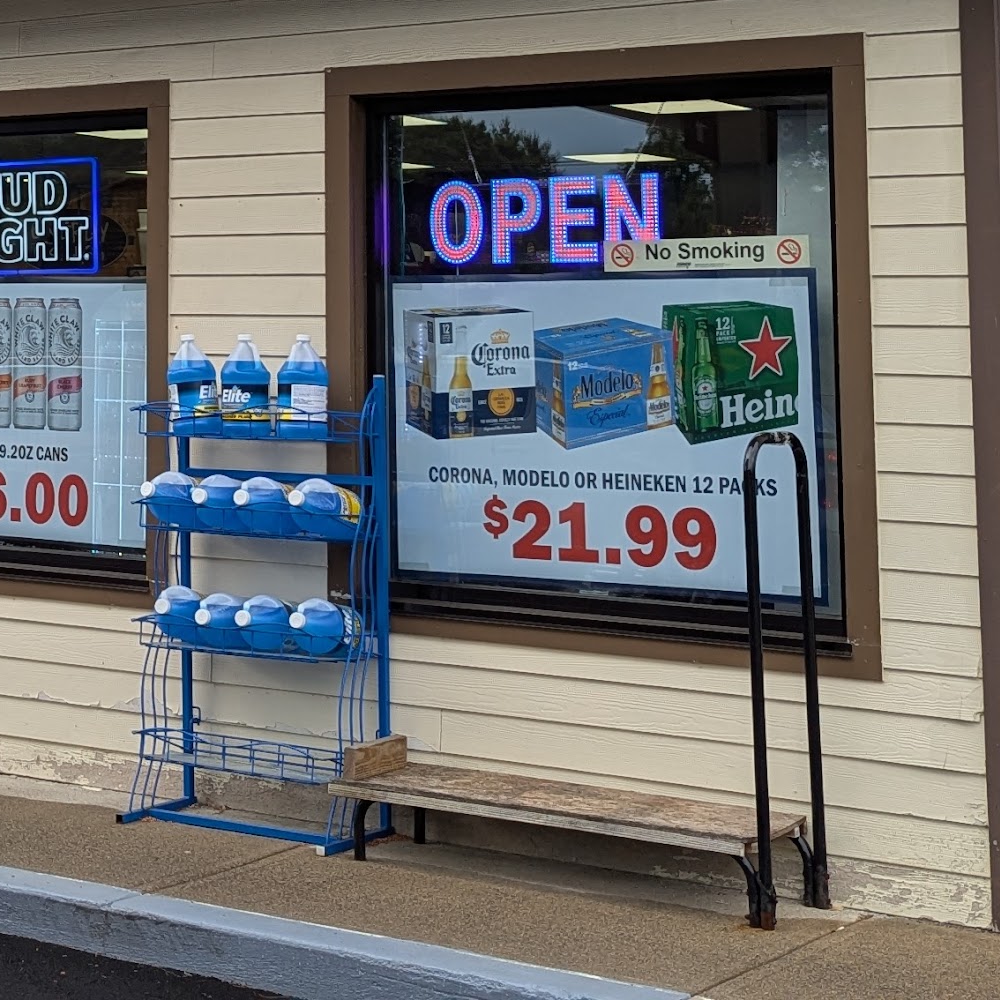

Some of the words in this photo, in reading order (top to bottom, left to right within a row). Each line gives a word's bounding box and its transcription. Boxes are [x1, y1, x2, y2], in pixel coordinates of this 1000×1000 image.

[430, 173, 661, 264] OPEN
[645, 244, 671, 260] No
[678, 242, 764, 262] Smoking
[442, 324, 450, 334] 12
[715, 317, 731, 331] 12
[471, 343, 530, 367] Corona
[487, 363, 516, 376] Extra
[567, 361, 578, 371] 12
[581, 369, 634, 399] Modelo
[222, 386, 251, 403] Elite
[36, 446, 69, 462] CANS
[428, 466, 498, 489] CORONA,
[502, 469, 570, 488] MODELO
[574, 471, 597, 489] OR
[601, 473, 686, 493] HEINEKEN
[692, 476, 714, 494] 12
[719, 477, 778, 497] PAKS
[482, 495, 717, 571] $21.99
